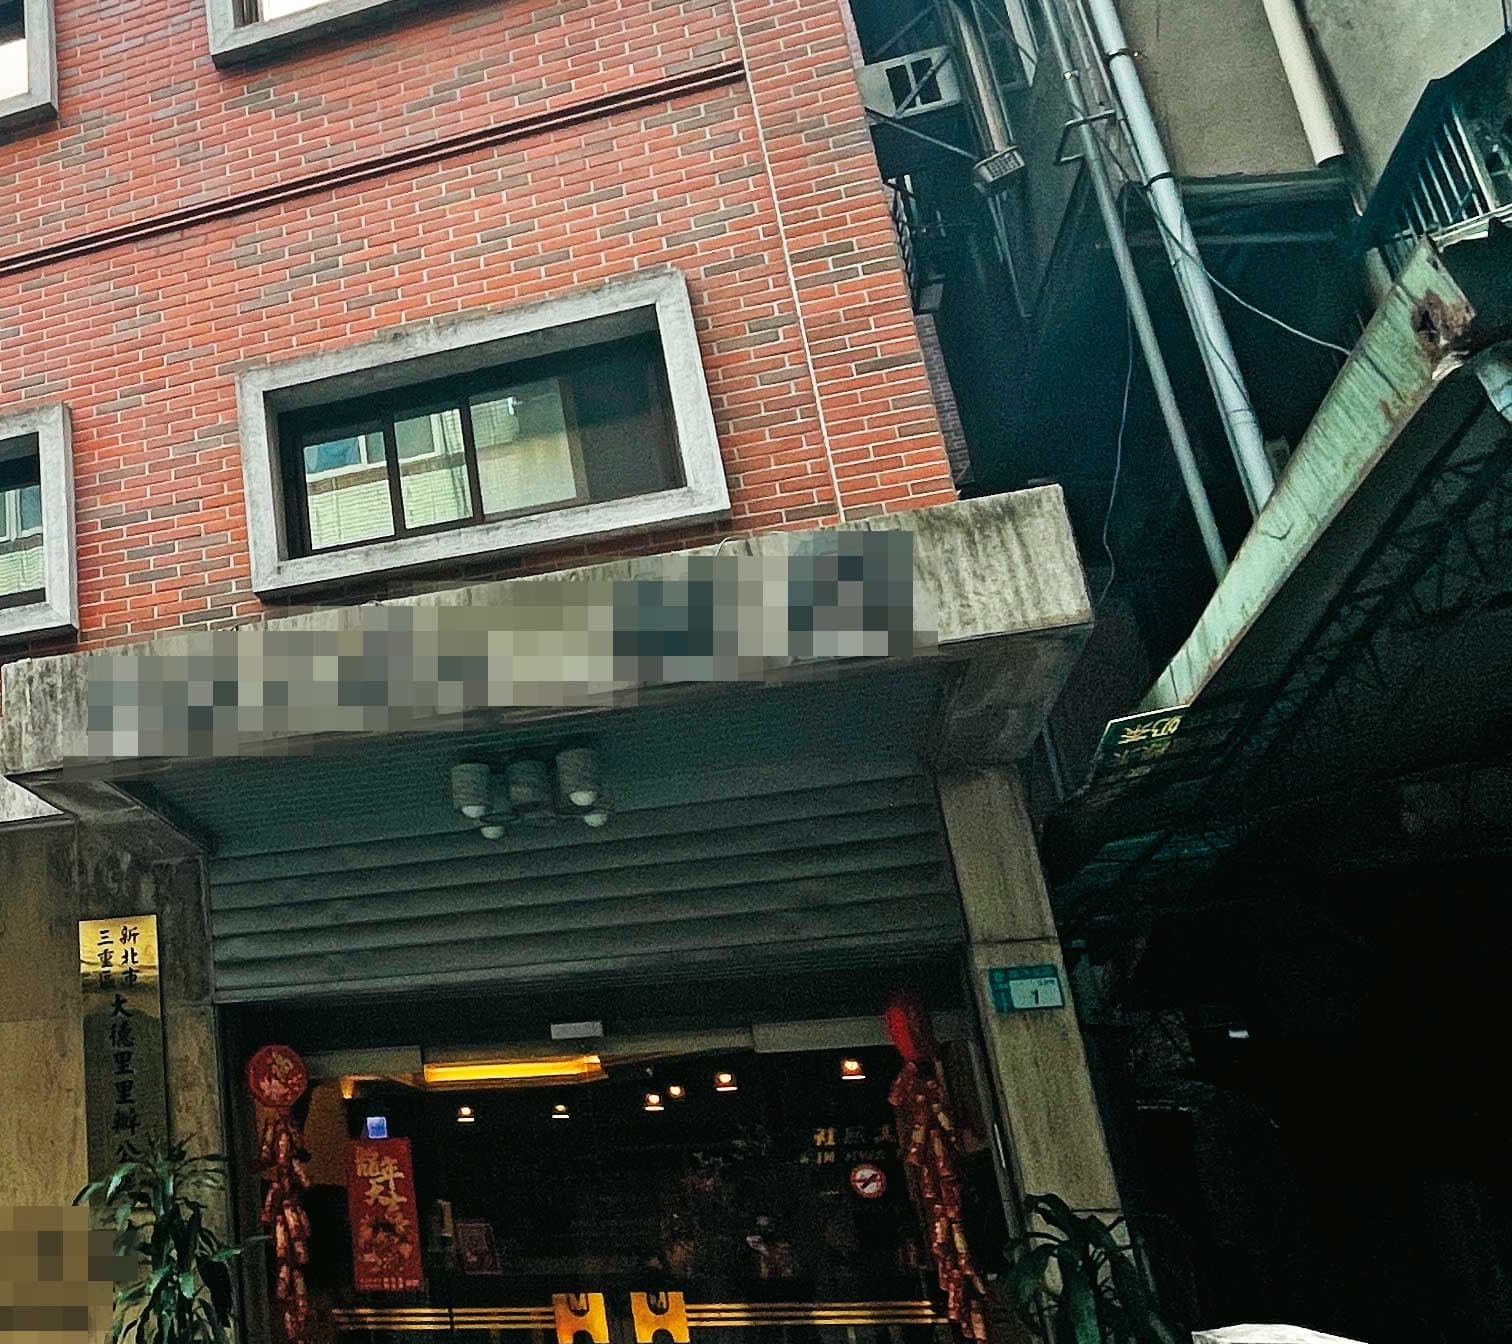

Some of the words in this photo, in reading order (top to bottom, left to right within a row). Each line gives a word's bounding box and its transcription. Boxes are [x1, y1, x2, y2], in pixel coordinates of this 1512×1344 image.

[119, 925, 139, 986] 新北市
[108, 993, 141, 1176] 大德里里辦公
